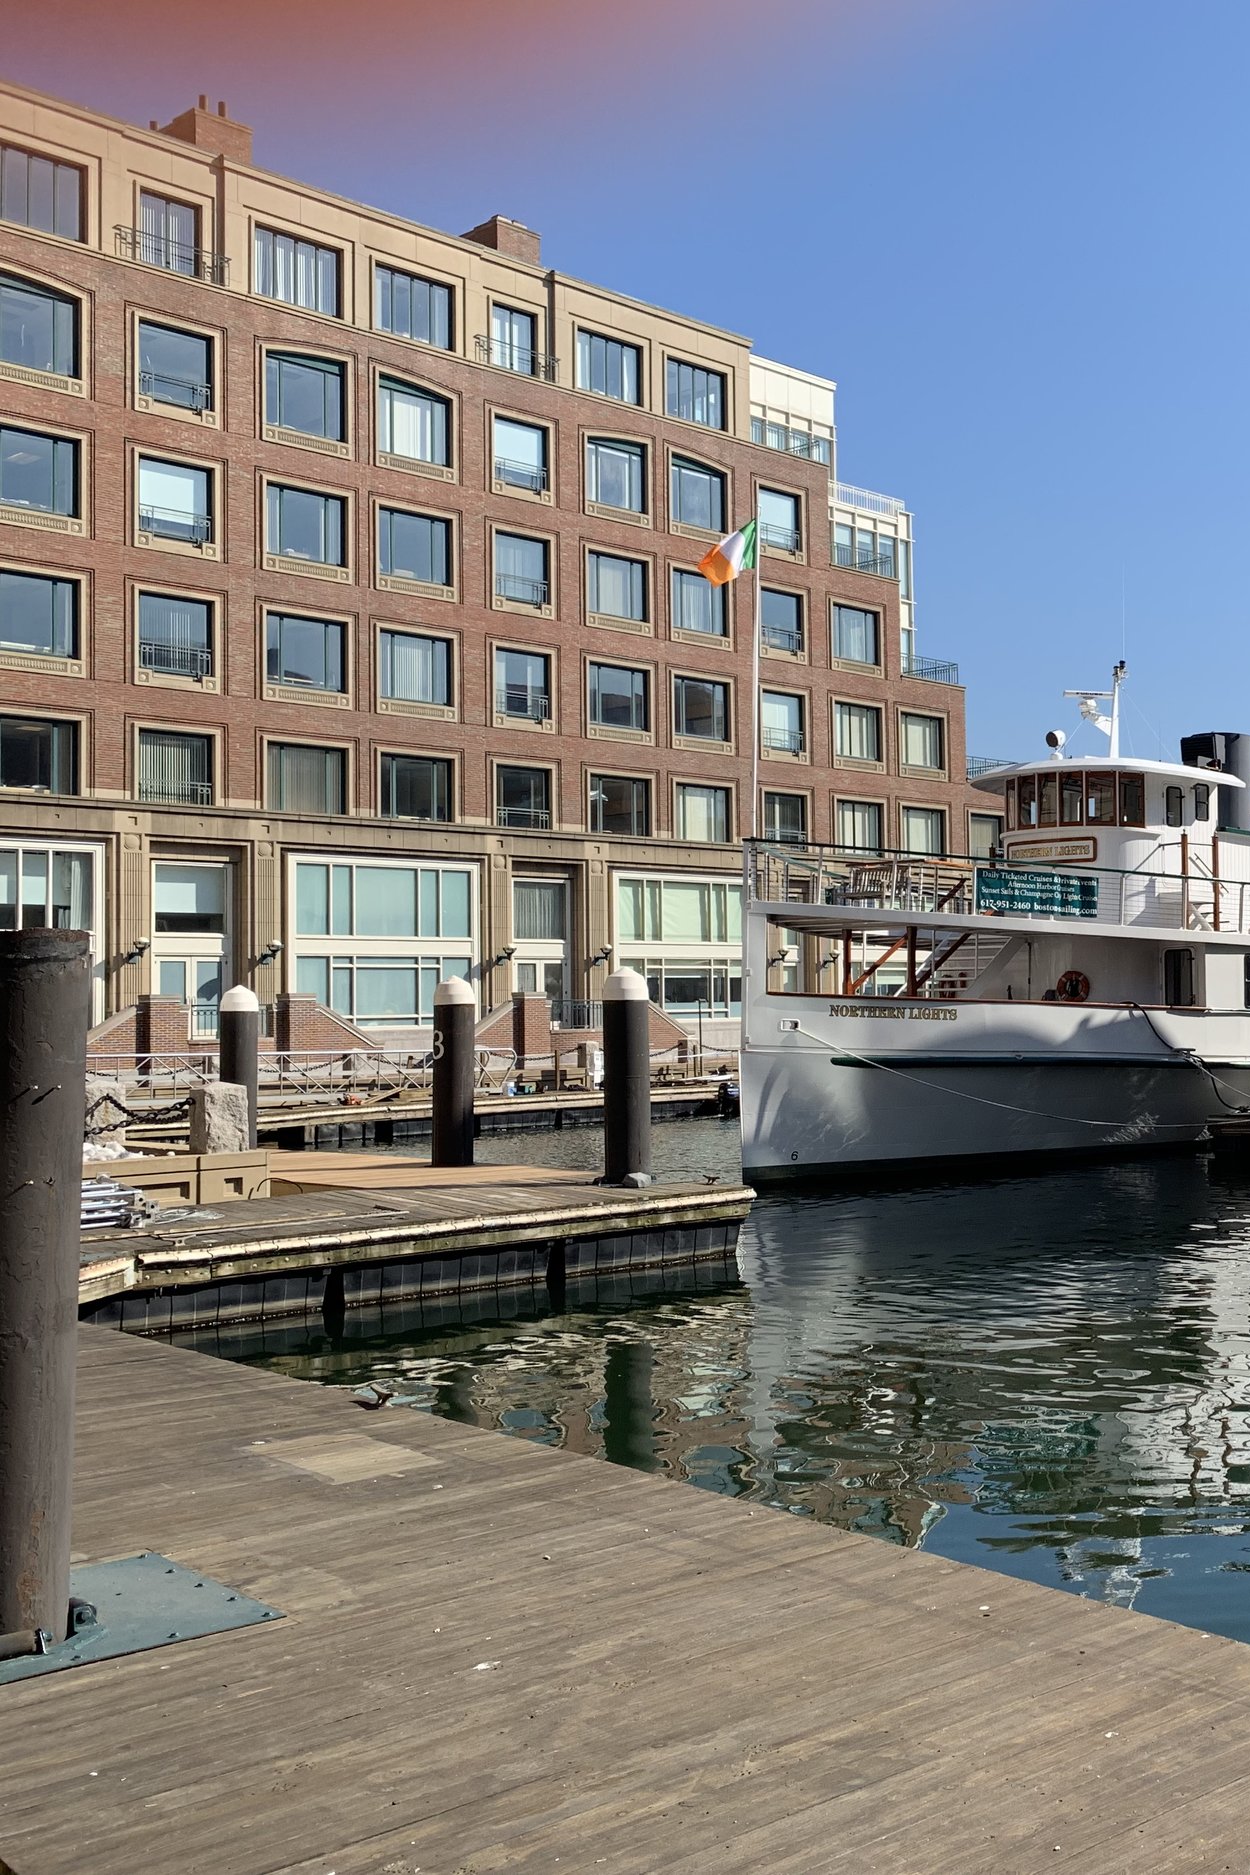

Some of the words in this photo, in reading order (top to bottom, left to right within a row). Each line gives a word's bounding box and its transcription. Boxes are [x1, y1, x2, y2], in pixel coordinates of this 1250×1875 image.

[982, 871, 999, 880] Daily
[1001, 872, 1027, 881] Ticketed
[1029, 874, 1052, 883] Cruises
[1008, 881, 1035, 889] Afternoon
[1037, 883, 1057, 891] Harbor
[982, 887, 1000, 895] Sunset
[1001, 888, 1013, 896] Sails
[1020, 890, 1053, 899] Champagne
[980, 899, 1031, 910] 617-951-2460
[829, 1005, 906, 1019] NORTHERN
[908, 1007, 957, 1021] LIGHTS
[433, 1030, 445, 1060] 3
[791, 1151, 799, 1161] 6
